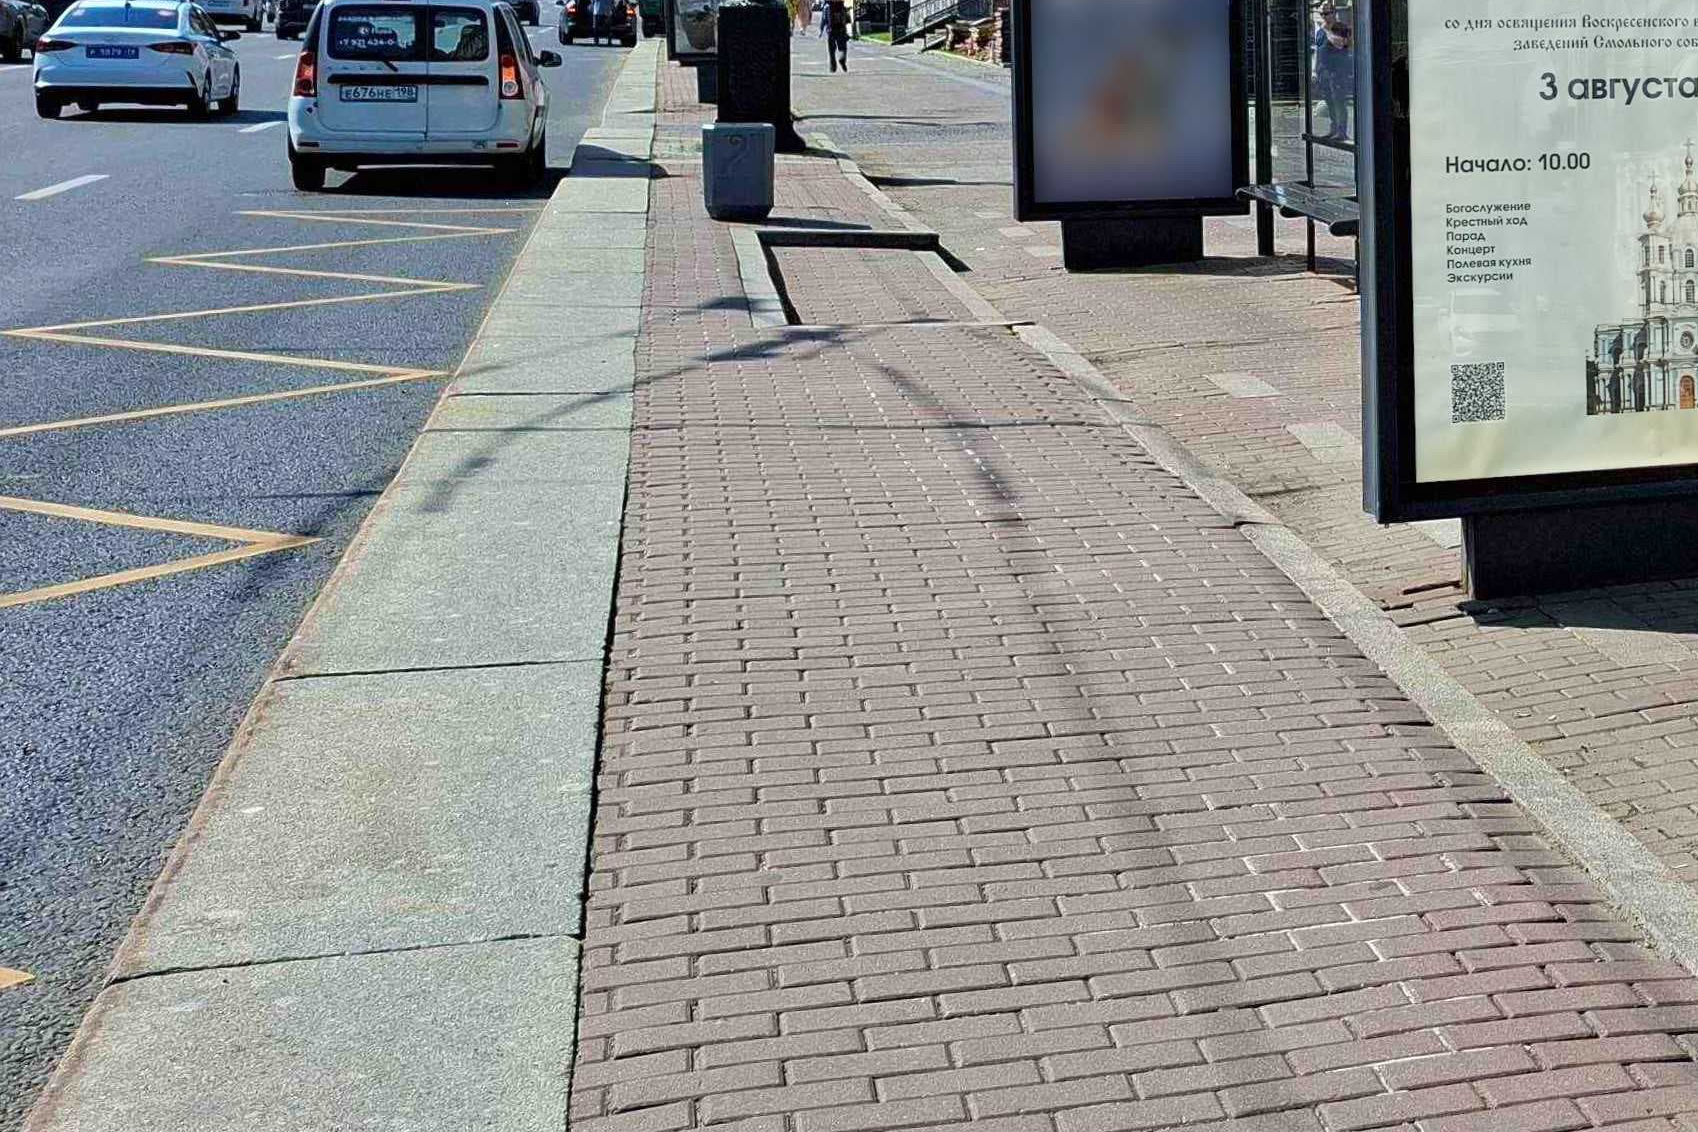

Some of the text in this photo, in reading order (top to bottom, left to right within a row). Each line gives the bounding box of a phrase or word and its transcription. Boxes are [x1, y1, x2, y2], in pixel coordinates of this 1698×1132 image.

[1445, 18, 1460, 29] со
[1464, 18, 1492, 31] дня
[1497, 17, 1577, 31] освящения
[1582, 14, 1689, 32] Воскресенского
[1513, 36, 1588, 52] заведений
[1593, 36, 1672, 50] Смольного
[1539, 72, 1558, 101] 3
[1446, 152, 1591, 173] Начало: 10.00
[1446, 203, 1532, 214] Богослужение
[1446, 216, 1528, 229] Крестный ход
[1446, 231, 1486, 243] Парад
[1446, 245, 1496, 256] Концерт
[1447, 258, 1532, 269] Полевая кухня
[1447, 272, 1513, 284] Экскурсии
